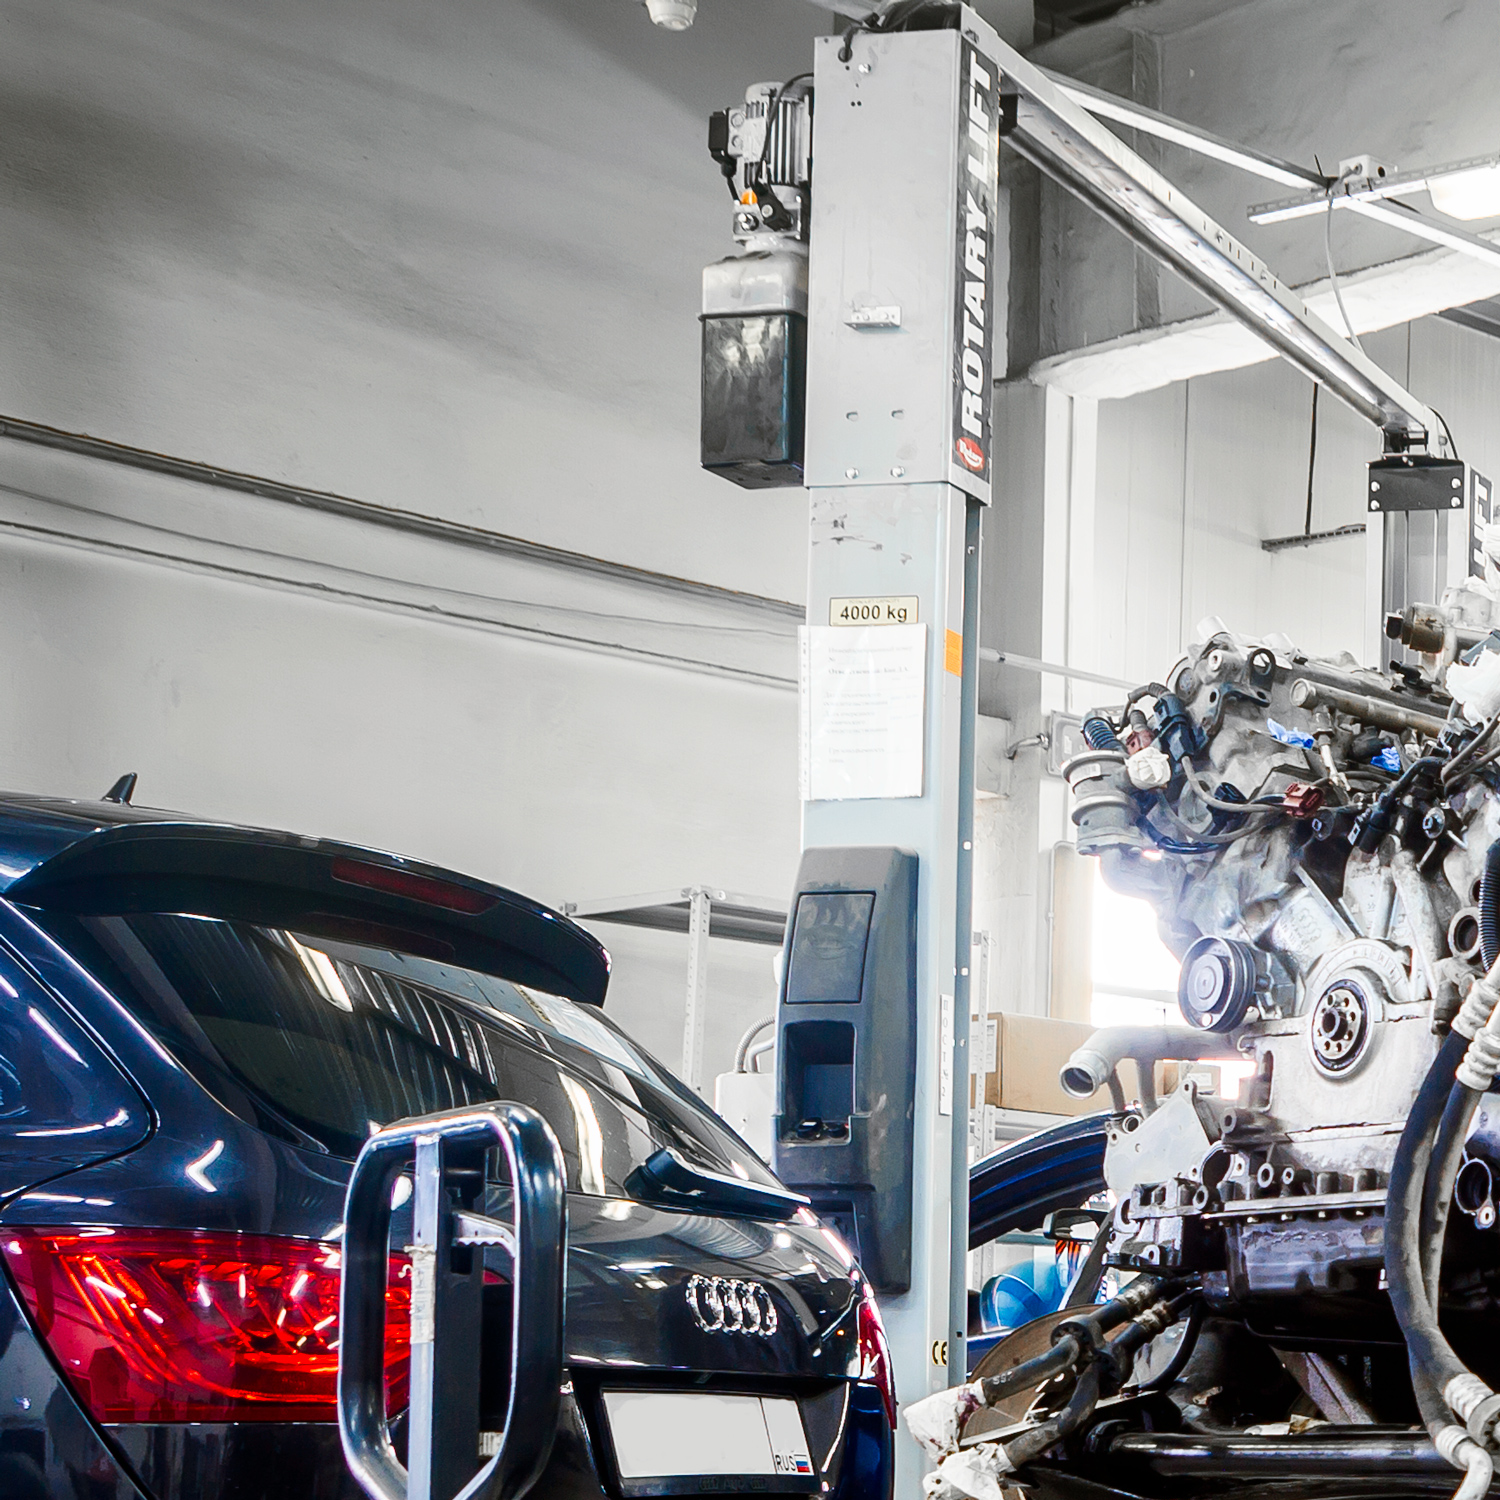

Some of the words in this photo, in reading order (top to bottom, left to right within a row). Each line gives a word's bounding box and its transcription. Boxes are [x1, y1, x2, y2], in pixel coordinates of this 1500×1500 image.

[967, 50, 992, 184] LIFT
[961, 191, 987, 439] ROTARY
[840, 605, 880, 620] 4000
[887, 604, 907, 622] kg
[775, 1454, 796, 1471] RUS
